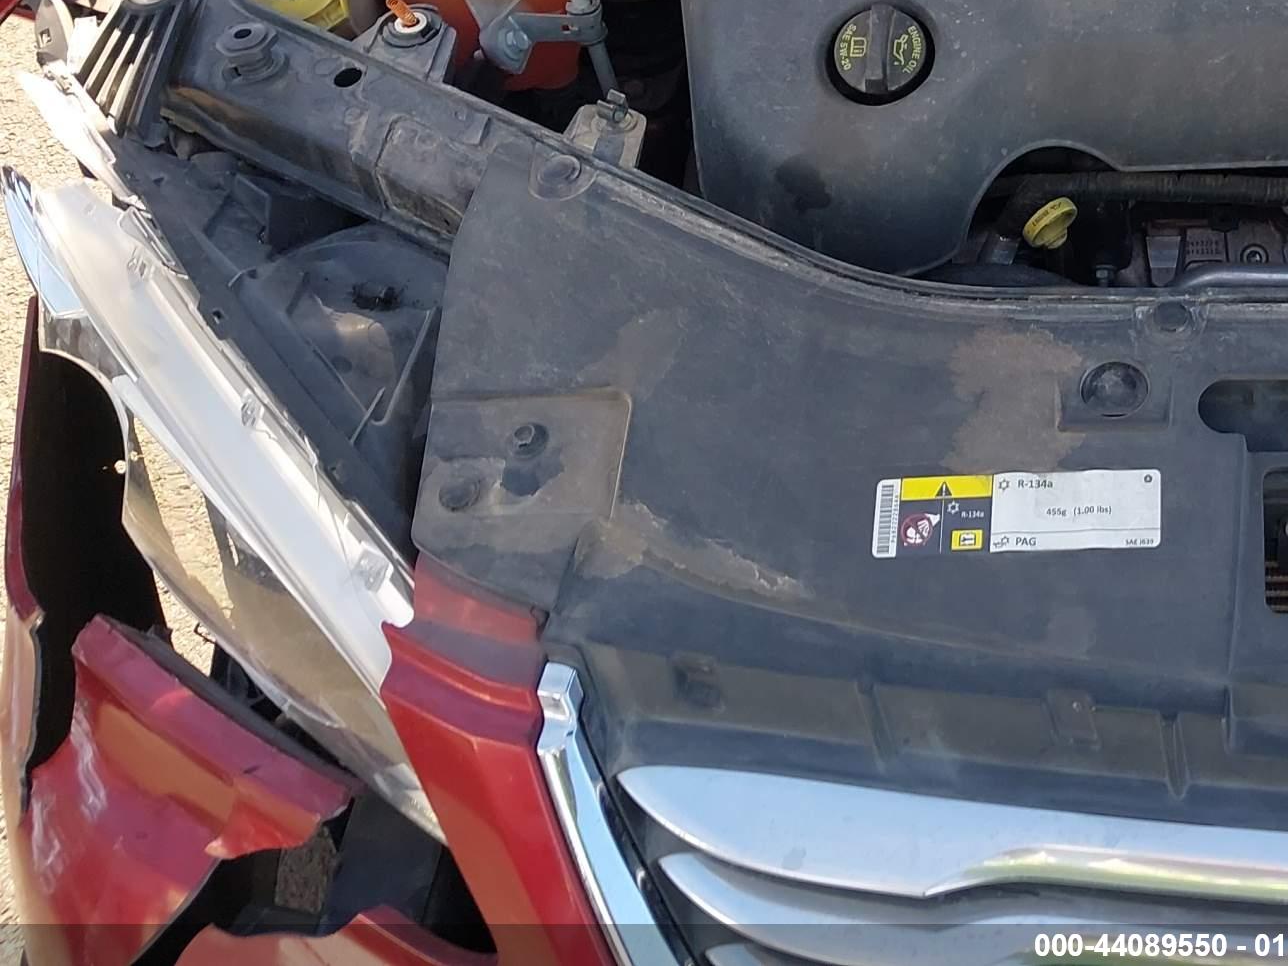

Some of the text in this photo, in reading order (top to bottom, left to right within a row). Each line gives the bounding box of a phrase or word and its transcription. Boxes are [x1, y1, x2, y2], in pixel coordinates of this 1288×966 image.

[902, 25, 922, 74] ENGINE OIL
[1017, 478, 1054, 489] R-134a
[1015, 537, 1037, 546] PAG
